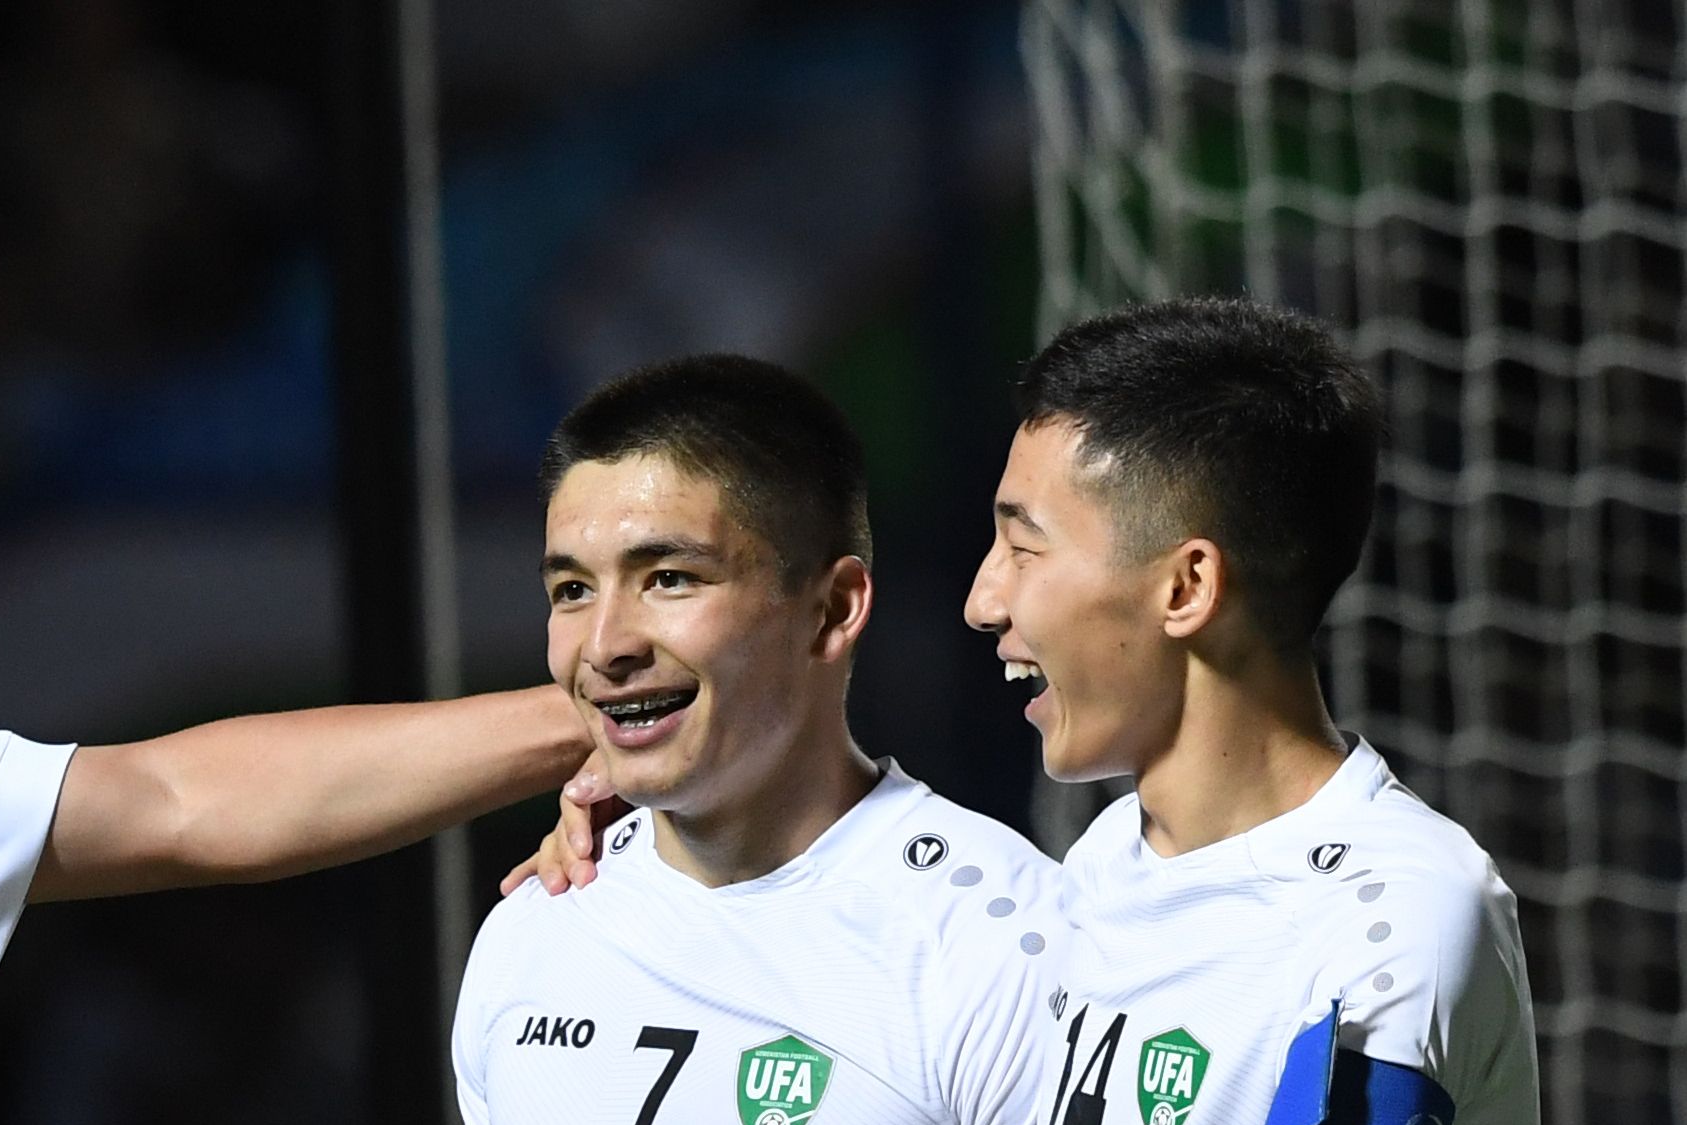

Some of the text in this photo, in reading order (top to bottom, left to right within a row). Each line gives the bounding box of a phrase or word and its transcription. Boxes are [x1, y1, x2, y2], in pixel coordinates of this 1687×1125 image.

[516, 1016, 596, 1049] JAKO
[745, 1057, 813, 1105] UFA
[1143, 1048, 1194, 1099] UFA
